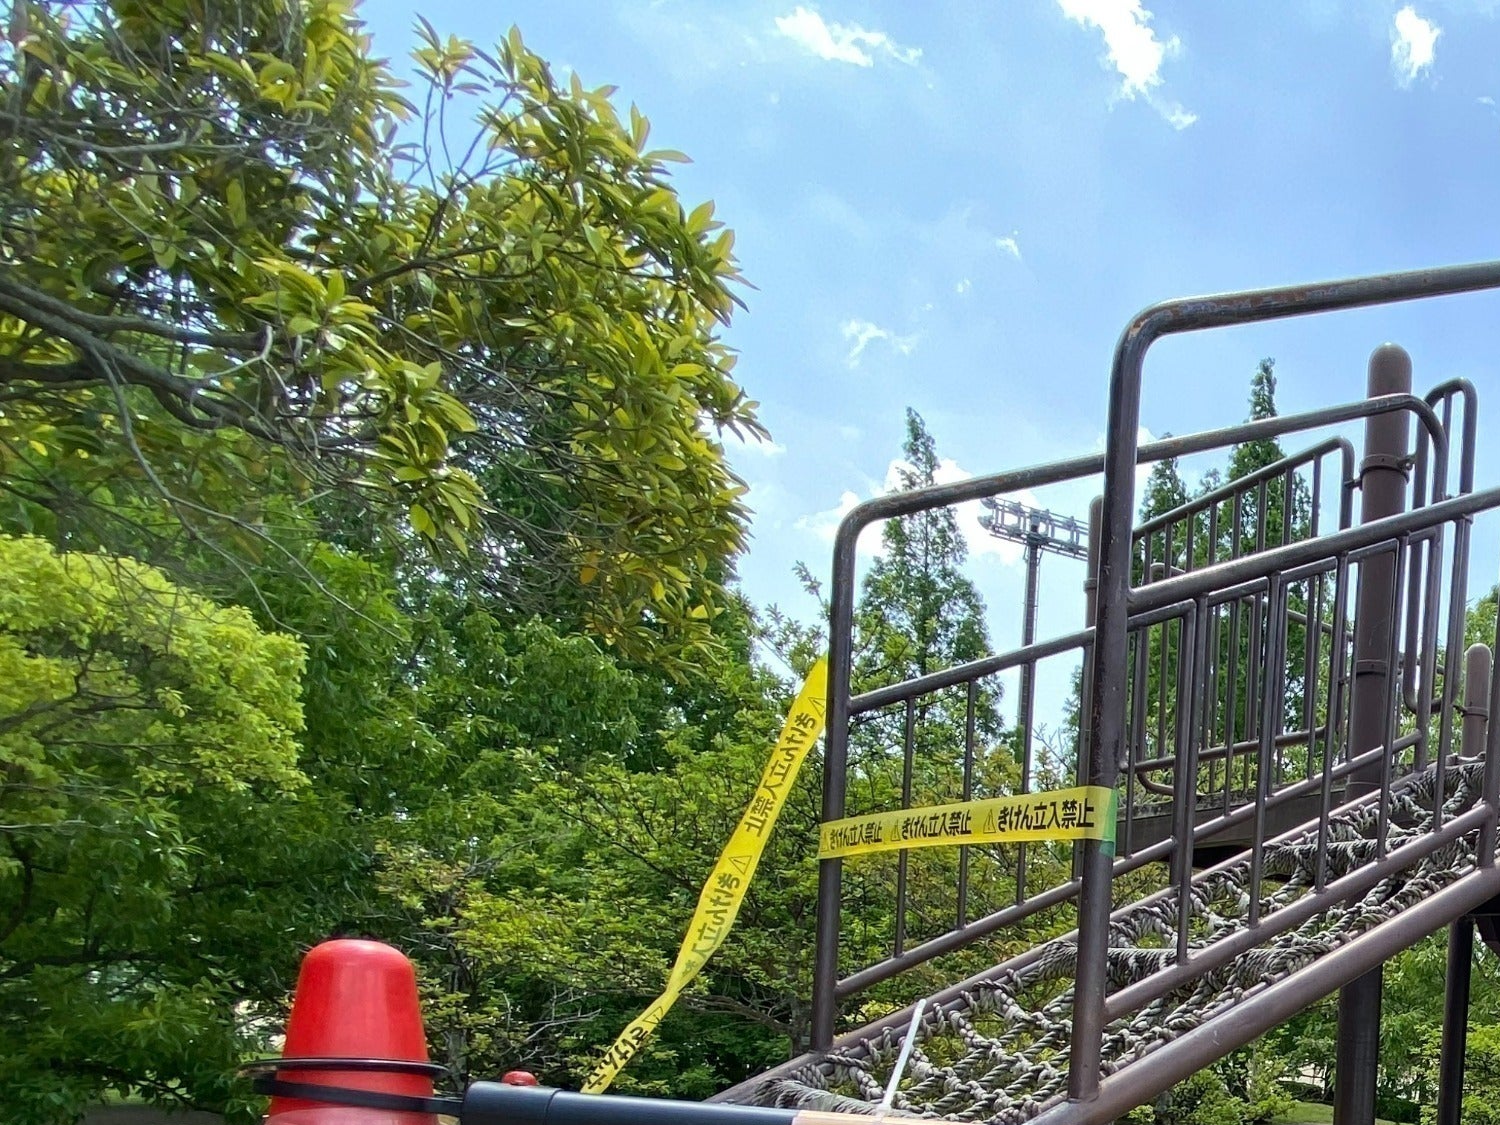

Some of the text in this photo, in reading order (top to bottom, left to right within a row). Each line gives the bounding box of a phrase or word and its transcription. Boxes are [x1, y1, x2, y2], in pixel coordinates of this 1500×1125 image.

[829, 797, 1095, 850] きけん立入禁止 きけん立入禁止 きけん立入禁止
